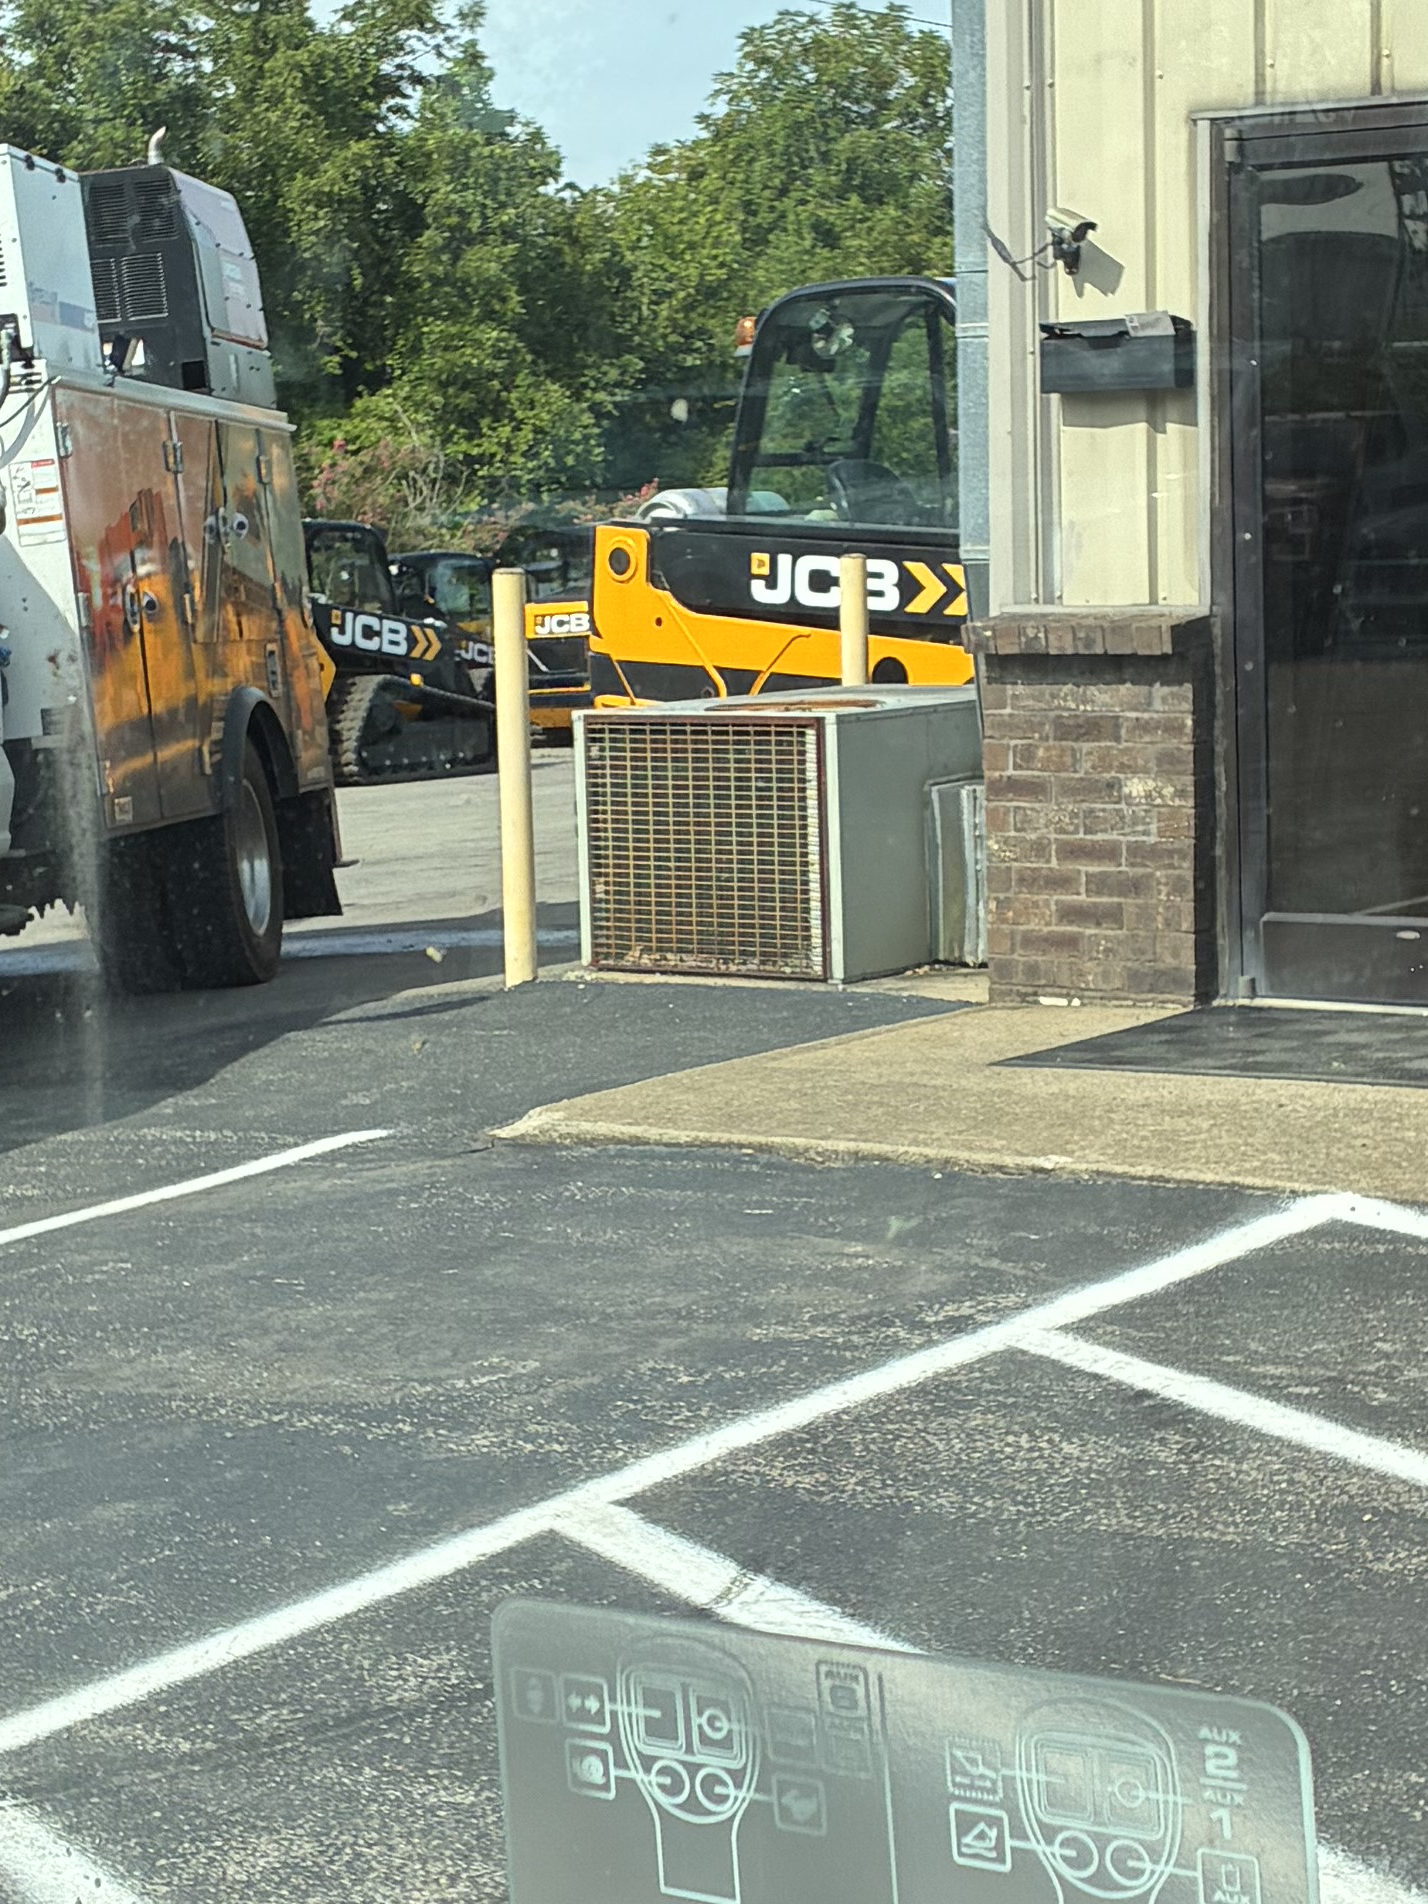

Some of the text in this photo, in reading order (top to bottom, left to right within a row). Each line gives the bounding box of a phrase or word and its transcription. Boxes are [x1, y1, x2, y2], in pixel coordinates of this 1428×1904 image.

[749, 552, 901, 612] JCB
[330, 610, 409, 657] JCB
[534, 612, 591, 635] JCB
[1197, 1724, 1244, 1746] AUX
[1204, 1744, 1240, 1780] 2
[1202, 1789, 1245, 1807] AUX
[1209, 1807, 1232, 1841] 1
